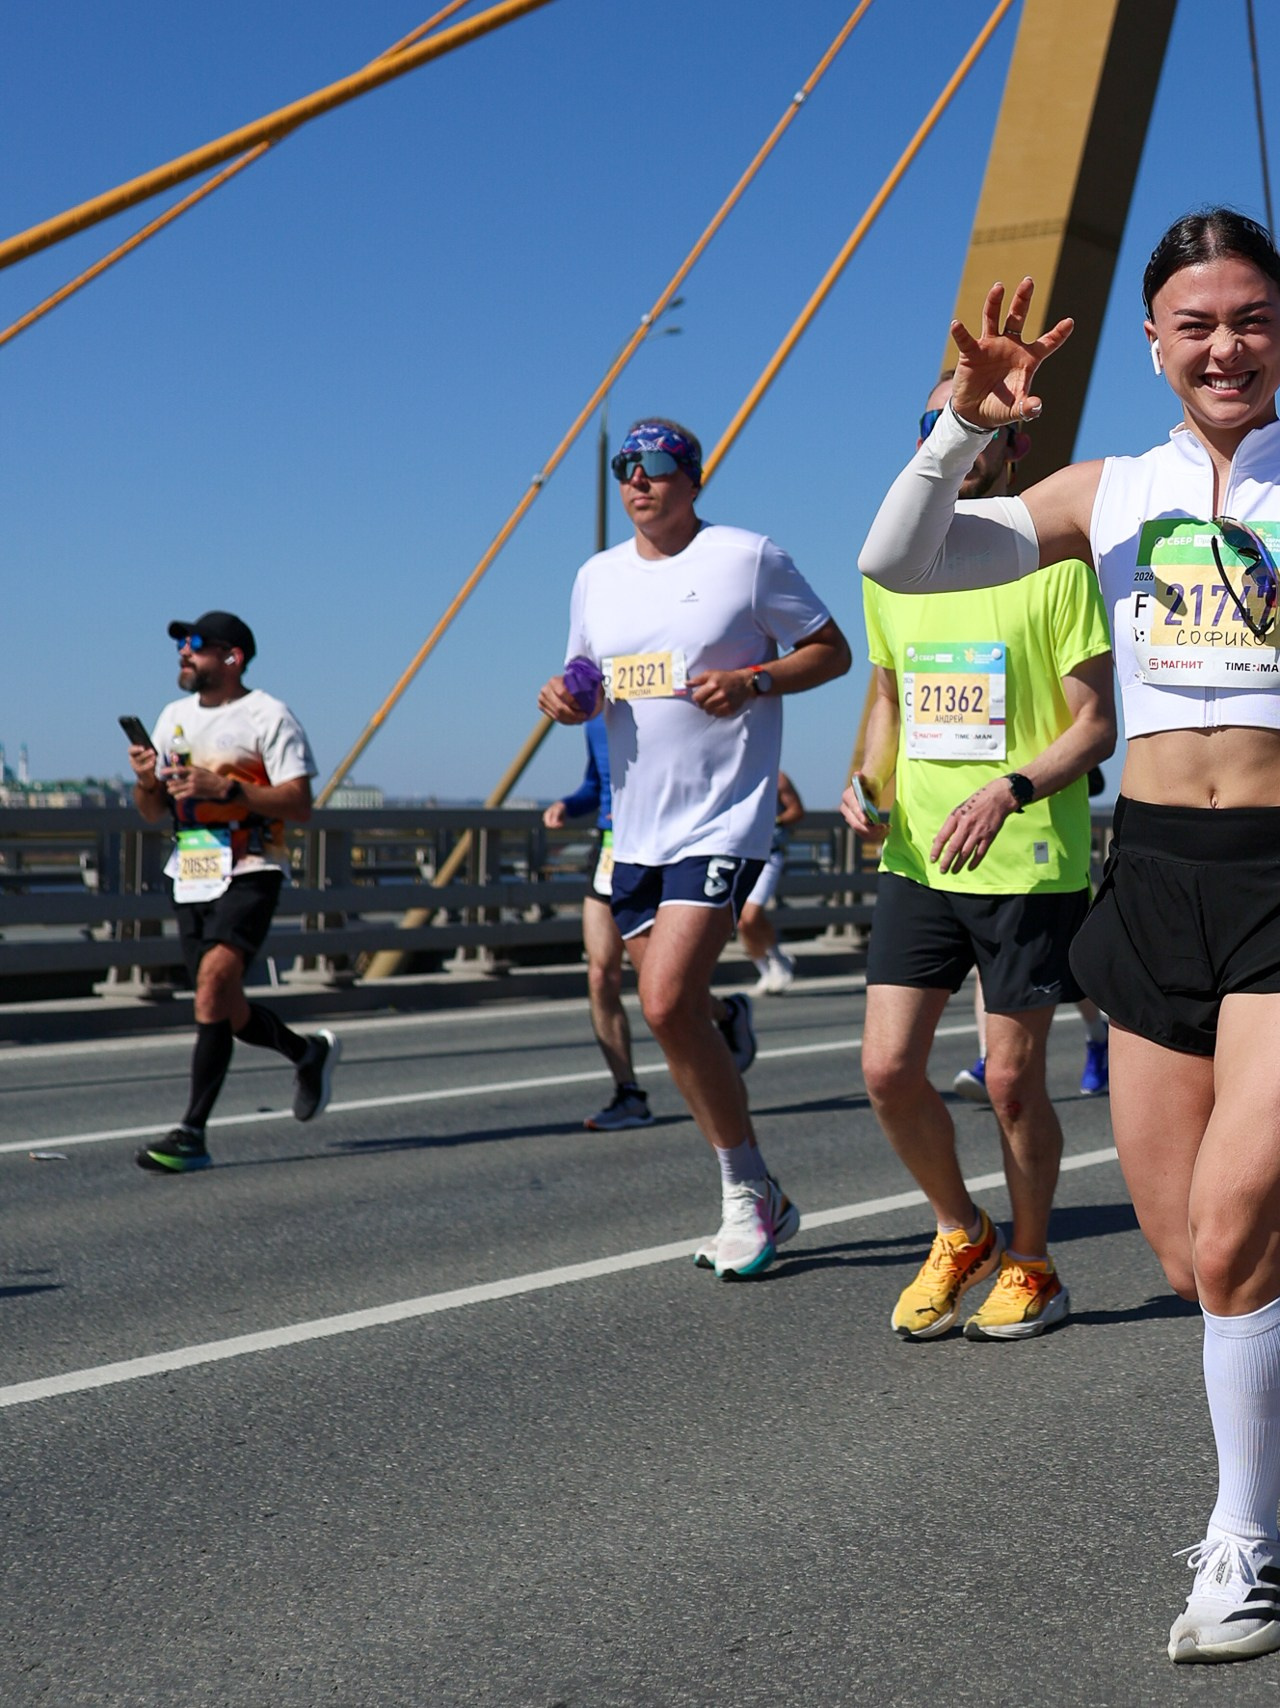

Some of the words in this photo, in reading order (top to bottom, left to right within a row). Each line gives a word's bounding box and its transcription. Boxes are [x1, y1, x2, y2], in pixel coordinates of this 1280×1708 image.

[1166, 536, 1192, 546] СБЕР
[1134, 571, 1154, 582] 2026
[1134, 593, 1150, 619] F
[1176, 629, 1267, 647] СОФИКО
[1160, 660, 1204, 670] МАГНИТ
[617, 661, 666, 690] 21321
[920, 685, 984, 713] 21362
[934, 714, 964, 725] АНДРЕЙ
